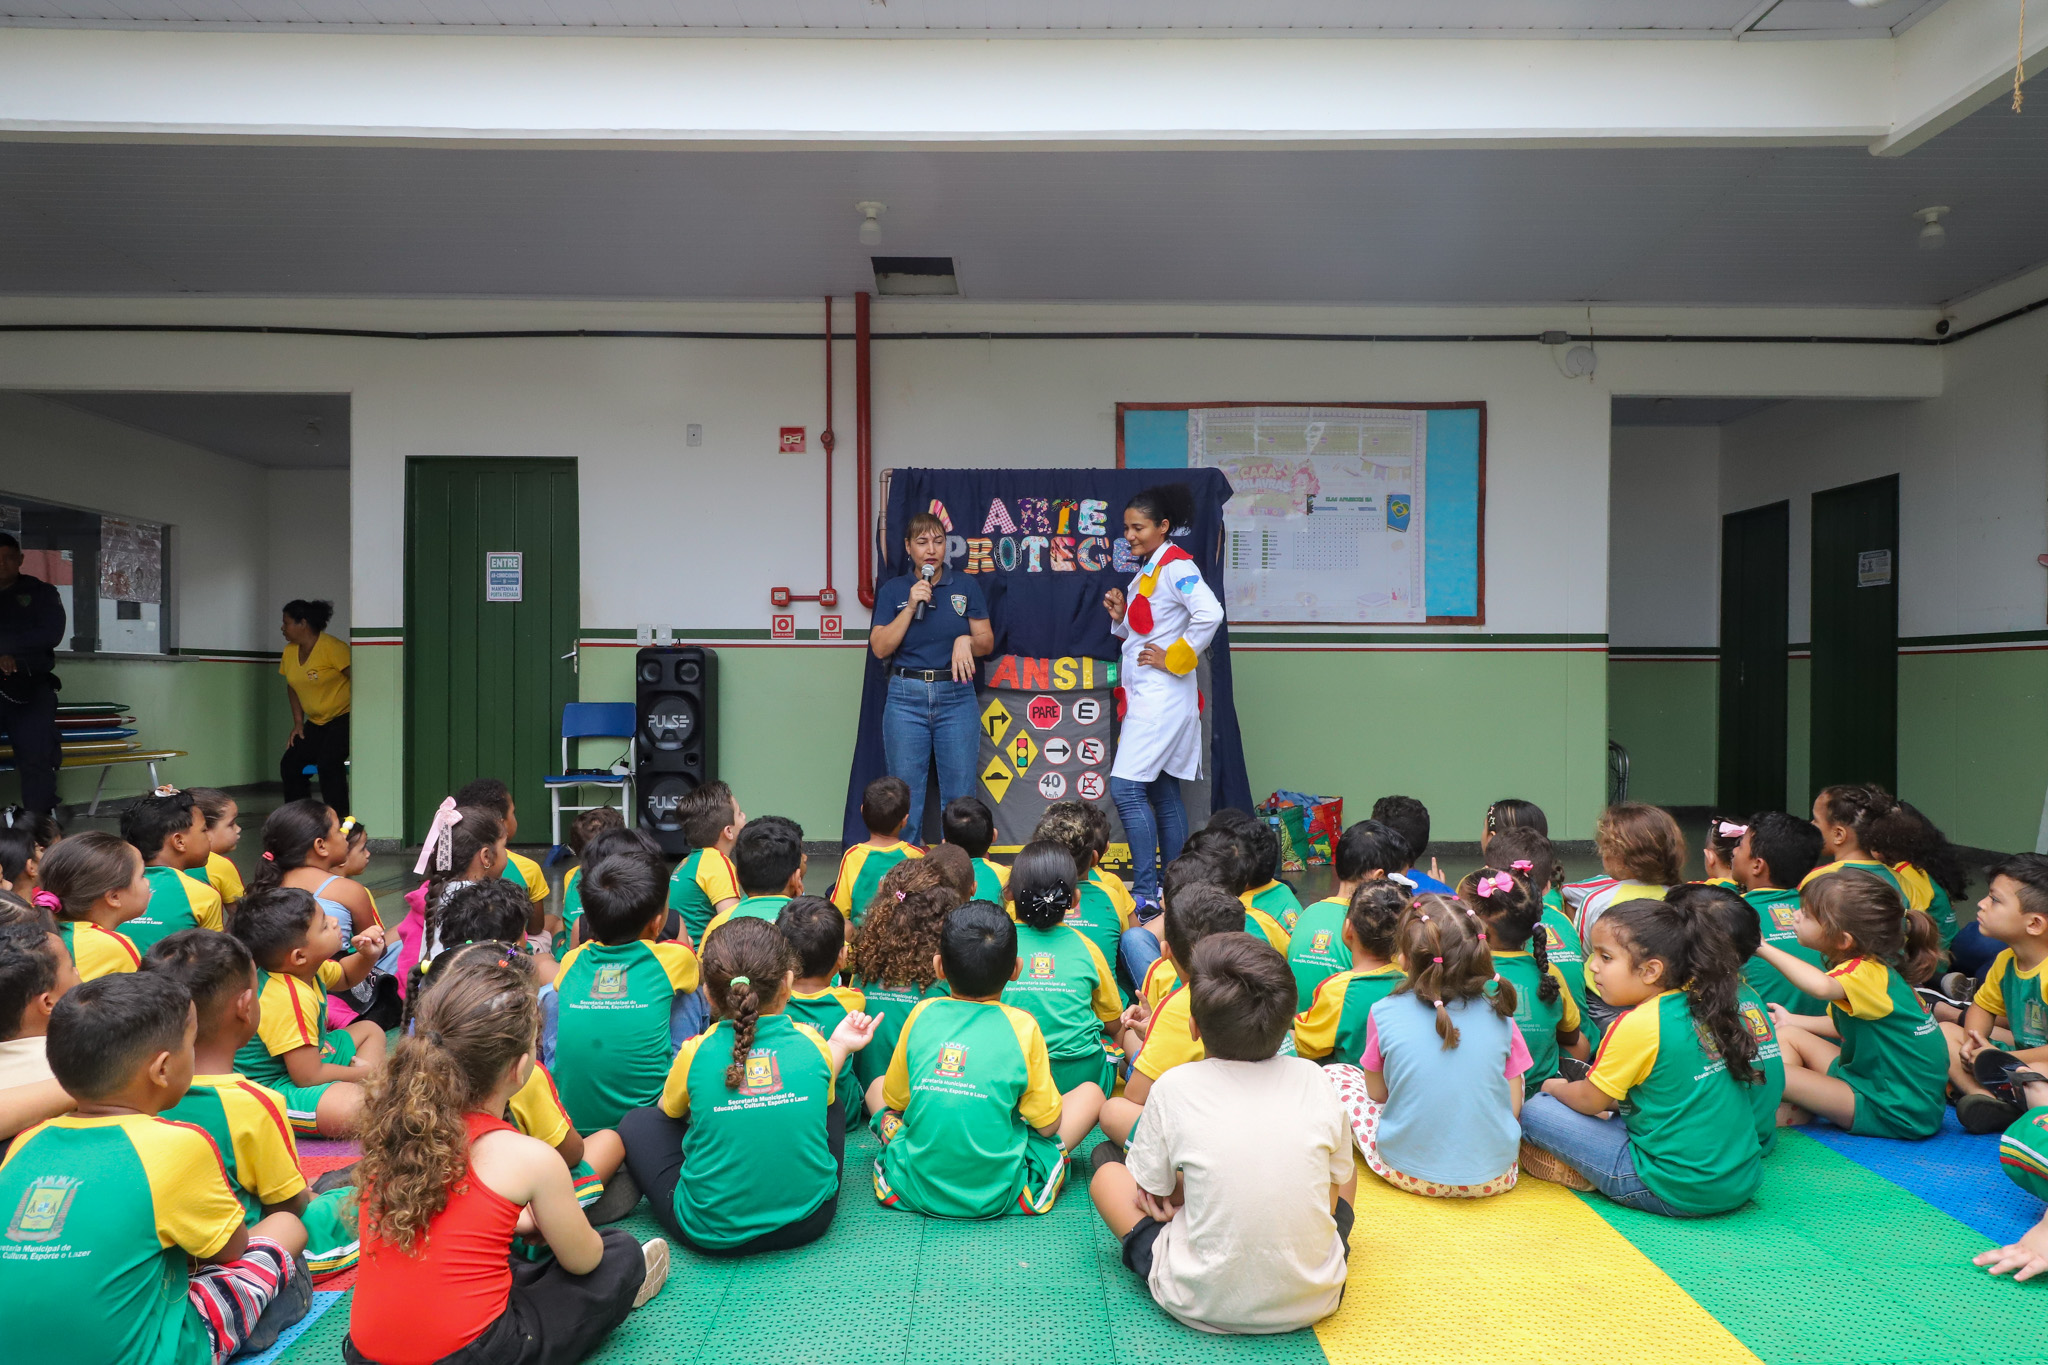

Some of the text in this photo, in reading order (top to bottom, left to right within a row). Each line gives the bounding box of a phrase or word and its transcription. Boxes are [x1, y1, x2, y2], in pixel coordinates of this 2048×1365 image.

[981, 497, 1109, 536] ARTE
[491, 558, 518, 568] ENTRE
[1032, 705, 1059, 719] PARE
[1077, 702, 1095, 720] E
[648, 714, 690, 728] PULSE
[1040, 774, 1062, 788] 40
[648, 795, 685, 809] PULS
[929, 1085, 949, 1093] Cultura,
[948, 1088, 970, 1096] Esporte
[943, 1079, 969, 1088] Municipal
[713, 1104, 744, 1113] Educação,
[743, 1101, 767, 1110] Cultura,
[767, 1098, 790, 1107] Esporte
[727, 1096, 759, 1106] Secretaria
[758, 1093, 787, 1102] Municipal
[2, 1251, 29, 1261] Cultura,
[29, 1252, 60, 1262] Esporte
[67, 1250, 92, 1259] Lazer
[22, 1244, 61, 1254] Municipal
[60, 1244, 72, 1252] de
